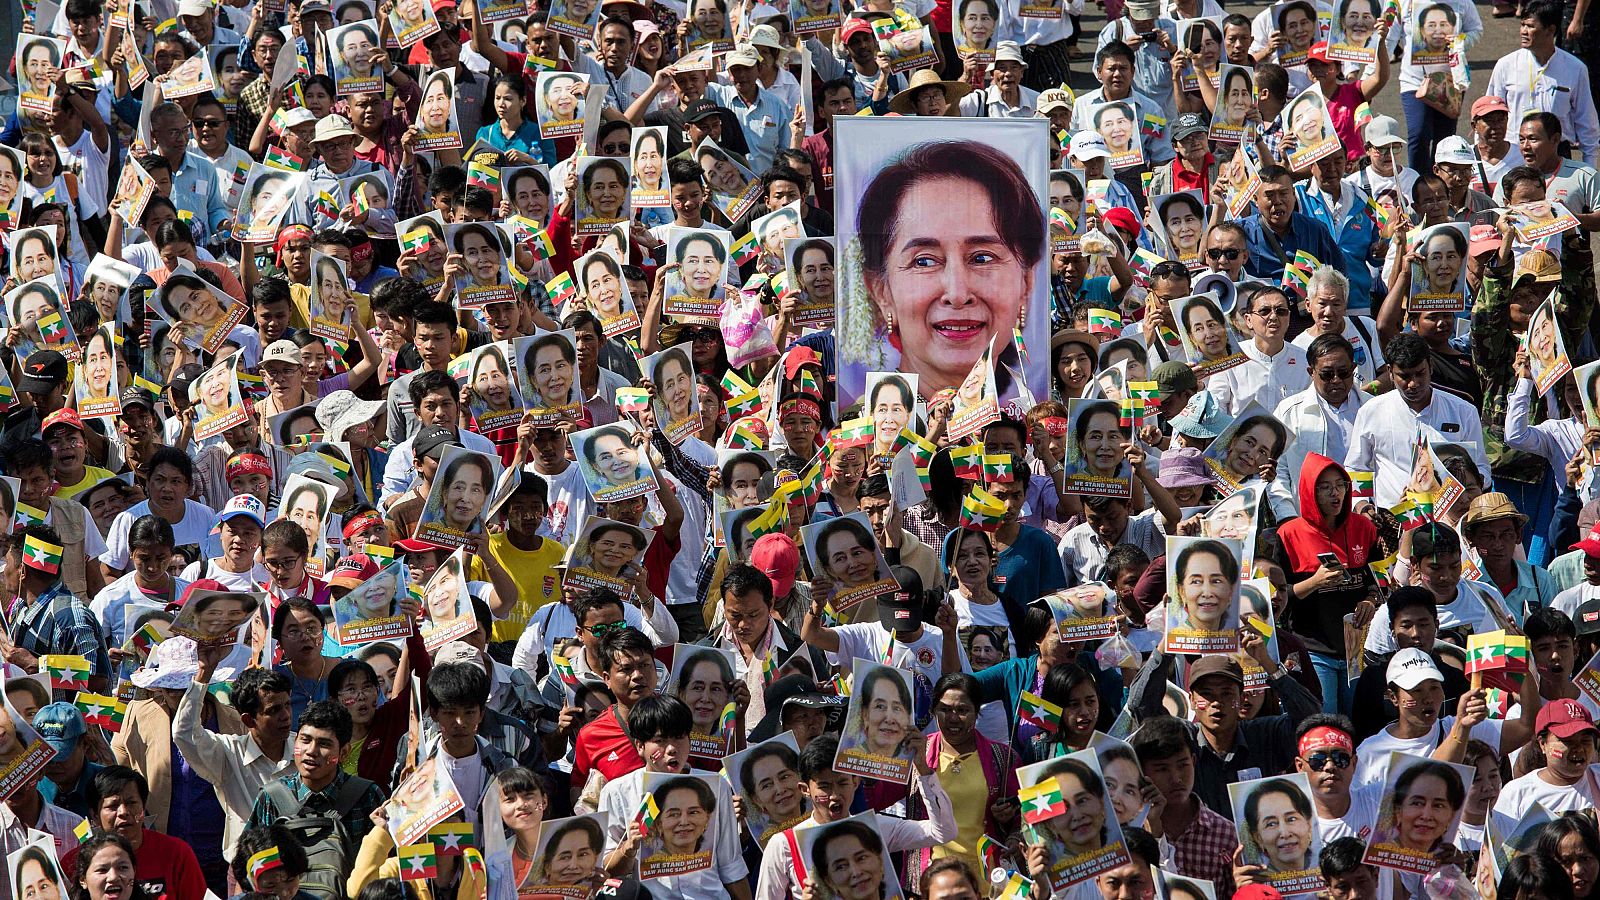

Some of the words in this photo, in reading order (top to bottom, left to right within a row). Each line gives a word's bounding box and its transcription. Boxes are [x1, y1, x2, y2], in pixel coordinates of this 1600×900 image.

[1047, 92, 1066, 103] NYC
[272, 347, 284, 355] CAT
[587, 578, 606, 586] STAND
[360, 625, 383, 633] STAND
[0, 776, 11, 787] WE
[8, 760, 29, 780] STAND
[27, 748, 43, 762] WITH
[851, 764, 869, 772] AUNG
[857, 759, 882, 769] STAND
[883, 764, 900, 772] WITH
[0, 784, 12, 797] DAW
[9, 772, 25, 787] AUNG
[22, 763, 35, 775] SAN
[32, 754, 44, 765] SUU
[662, 860, 685, 868] STAND
[1059, 869, 1070, 878] WE
[1072, 860, 1096, 873] STAND
[1098, 852, 1116, 863] WITH
[1382, 857, 1402, 866] AUNG
[1389, 853, 1416, 862] STAND
[1417, 858, 1436, 866] WITH
[1055, 878, 1068, 887] DAW
[1071, 871, 1087, 880] AUNG
[1088, 866, 1100, 874] SAN
